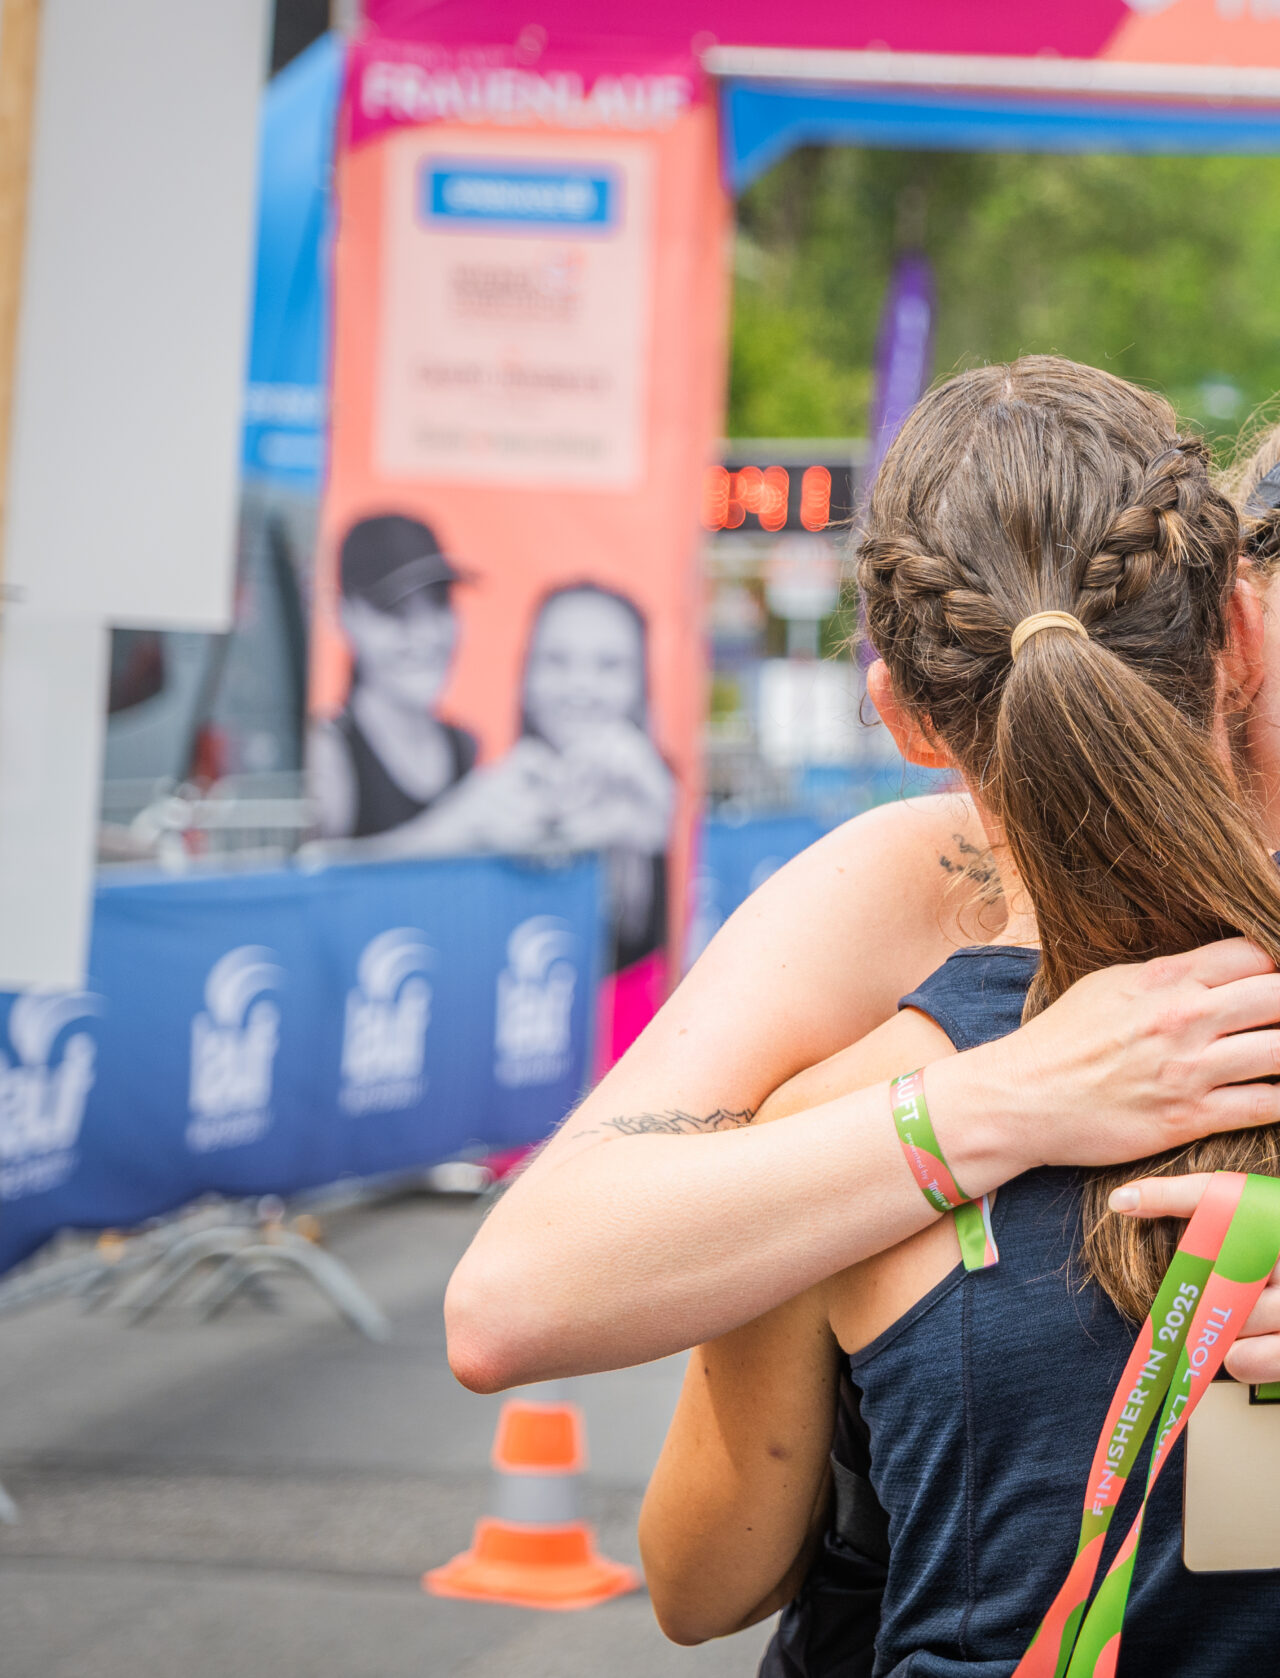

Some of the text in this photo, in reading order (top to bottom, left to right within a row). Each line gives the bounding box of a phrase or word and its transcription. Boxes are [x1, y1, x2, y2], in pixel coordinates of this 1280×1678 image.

[363, 62, 690, 131] FRAUENLAUF
[905, 1132, 926, 1170] presented
[1158, 1281, 1199, 1342] 2025
[1183, 1306, 1232, 1383] TIROL
